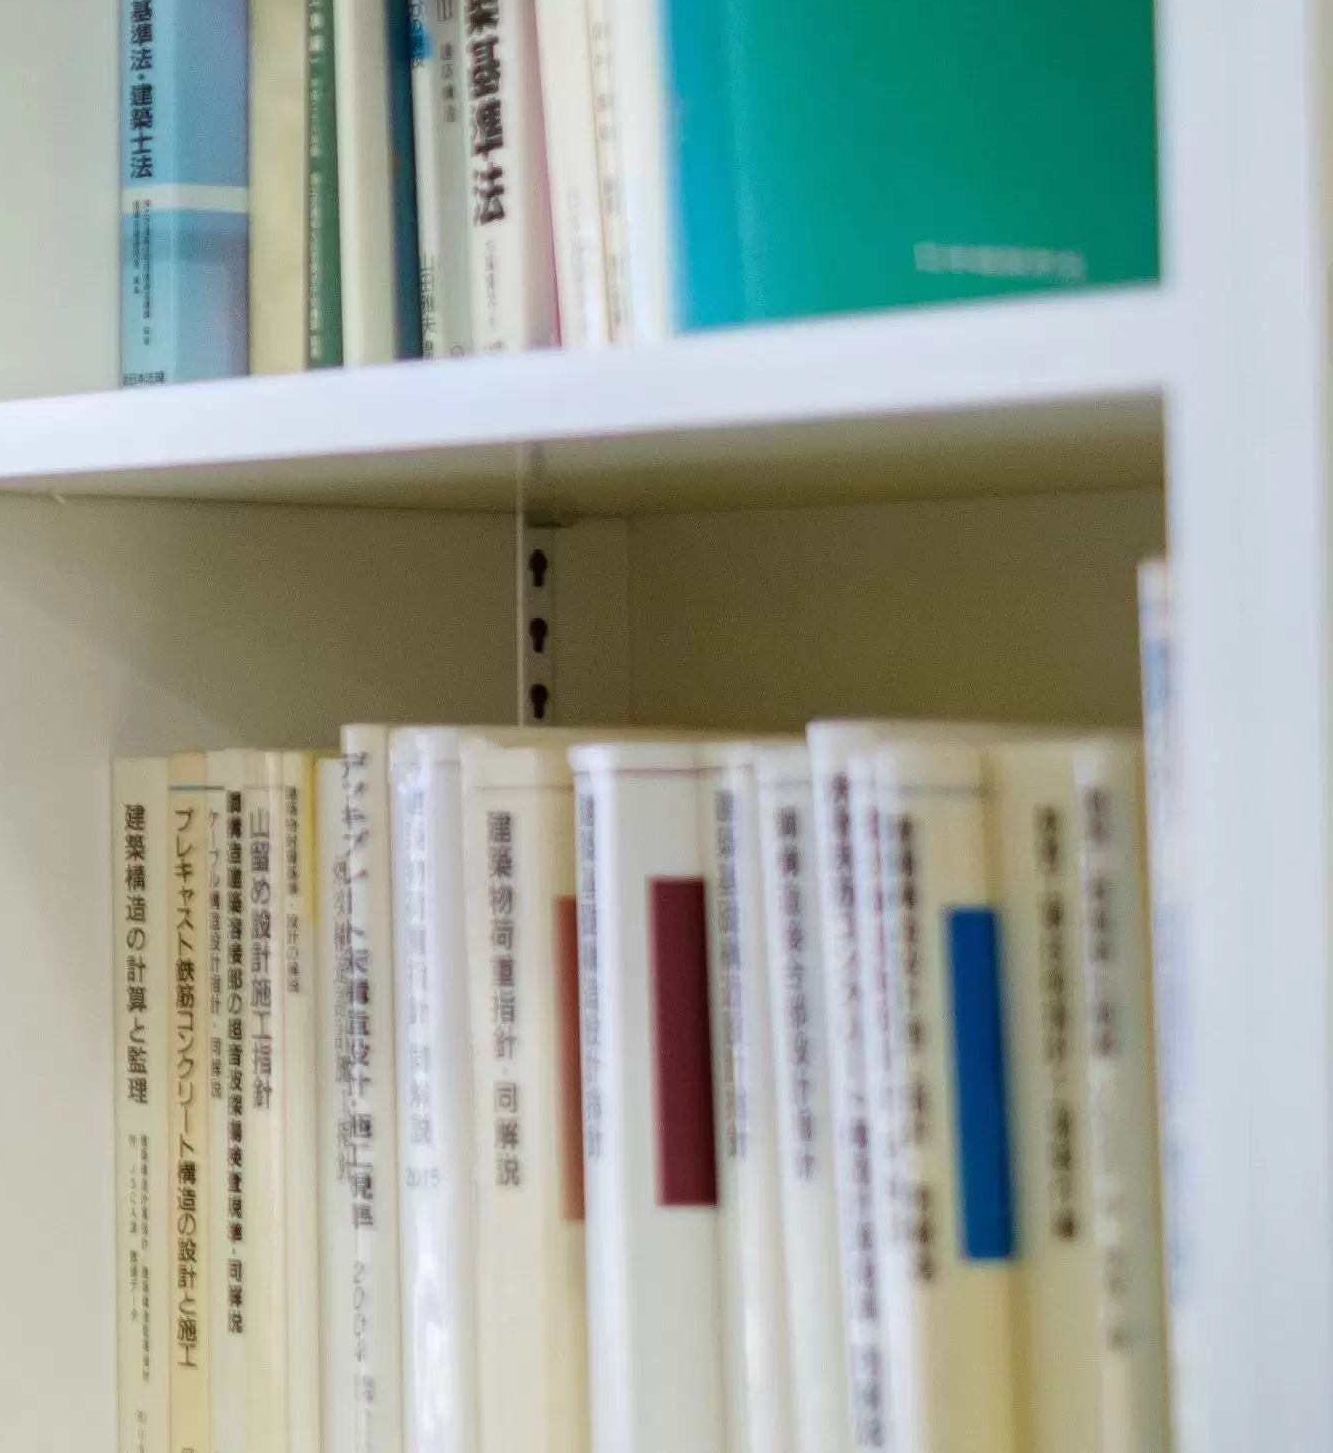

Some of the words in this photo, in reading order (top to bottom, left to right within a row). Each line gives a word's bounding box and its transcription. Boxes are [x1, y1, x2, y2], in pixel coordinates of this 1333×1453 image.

[125, 803, 149, 1104] 建築構造の計算と監理
[175, 808, 199, 1370] プレキャスト鉄筋コンクリート構造の設計と施工
[249, 807, 273, 1110] 山留め設計施工指針
[487, 810, 522, 1187] 建築物荷重指針・同解説
[351, 1258, 366, 1363] 2004
